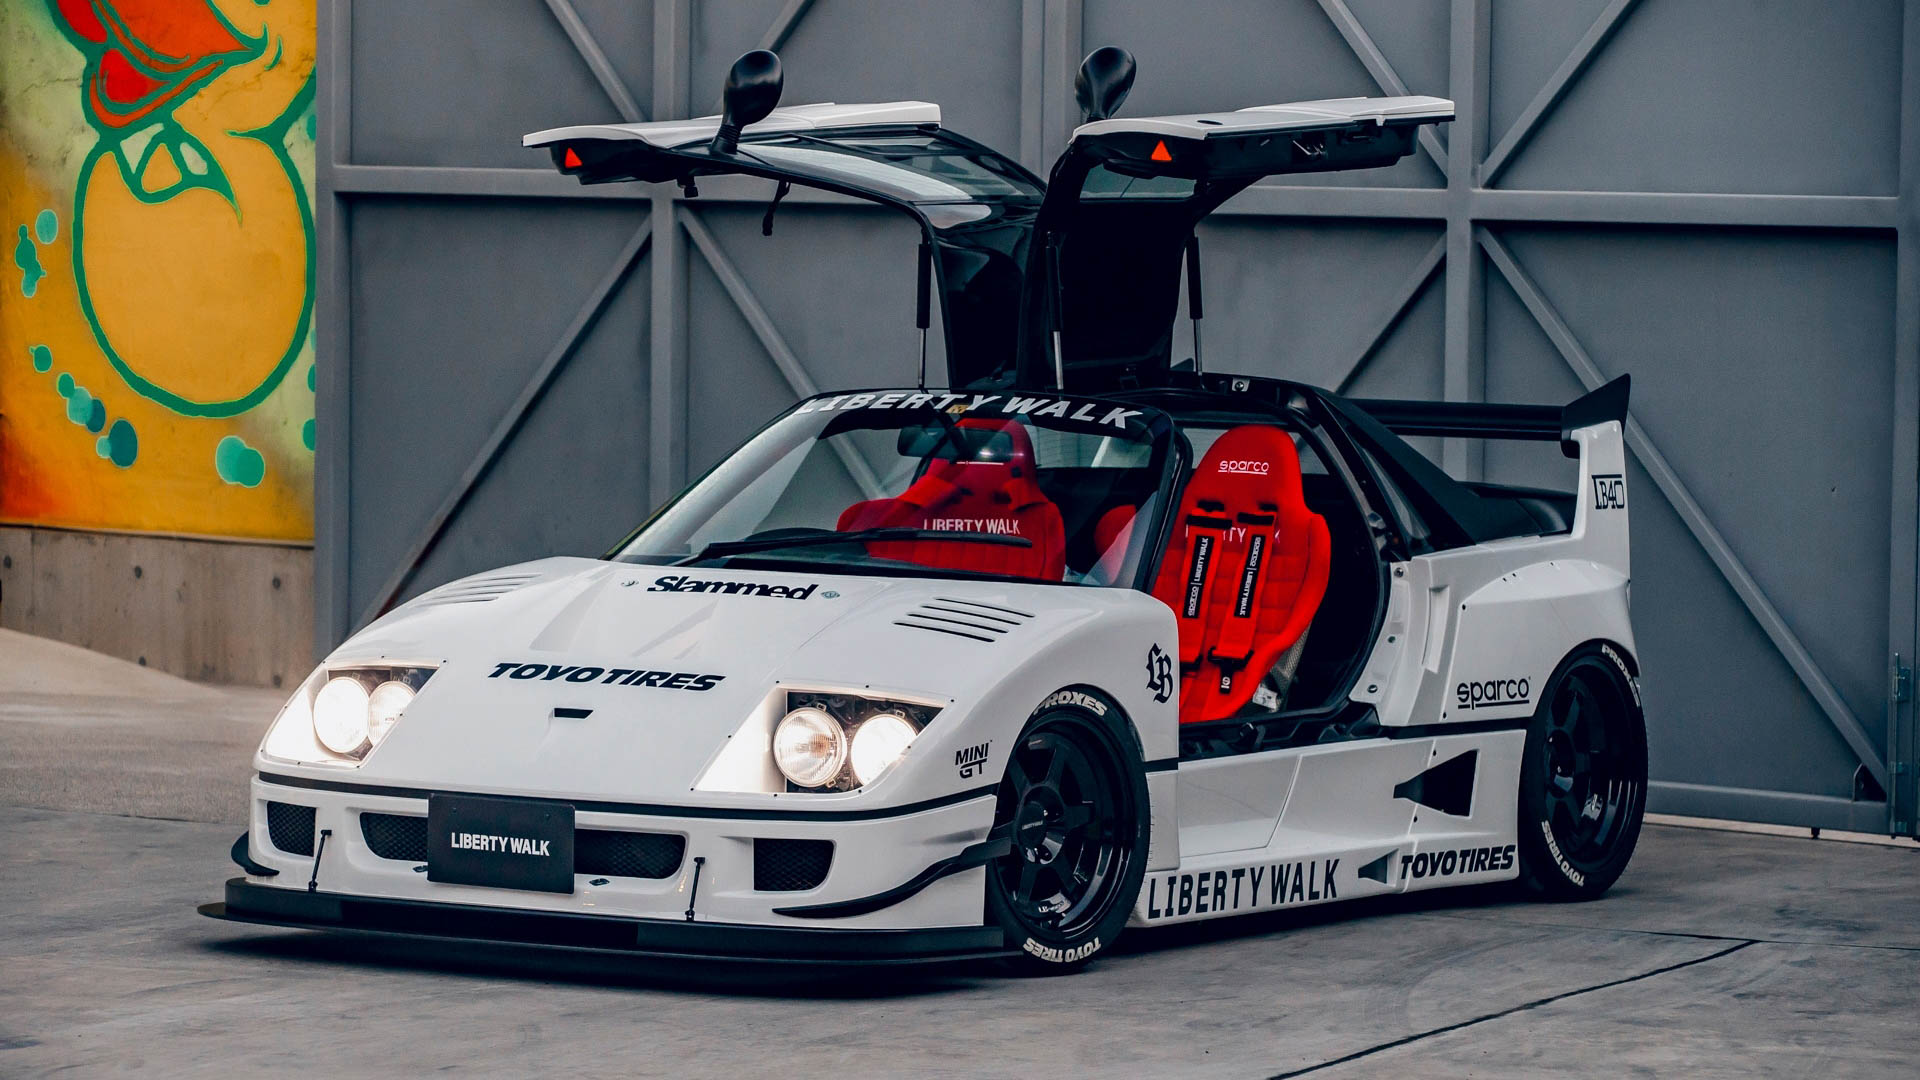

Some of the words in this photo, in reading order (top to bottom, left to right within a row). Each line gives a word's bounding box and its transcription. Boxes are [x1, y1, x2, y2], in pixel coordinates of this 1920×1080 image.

[793, 393, 1002, 415] LIBERTY
[1001, 396, 1143, 429] WALK
[1218, 459, 1269, 475] sparco
[923, 518, 984, 533] LIBERTY
[985, 518, 1021, 535] WALK
[647, 575, 819, 600] Slammed
[488, 662, 605, 683] TOYO
[598, 668, 726, 691] TIRES
[1033, 690, 1107, 717] PROXES
[955, 743, 989, 766] MINI
[959, 758, 988, 779] GT
[451, 831, 509, 853] LIBERTY
[509, 837, 550, 857] WALK
[1541, 820, 1564, 866] TIRES
[1400, 849, 1457, 880] TOYO
[1458, 845, 1515, 872] TIRES
[1560, 860, 1585, 888] TOYO
[1148, 866, 1264, 919] LIBERTY
[1270, 859, 1340, 905] WALK
[1022, 937, 1064, 963] TIRES
[1064, 936, 1102, 963] TOYO
